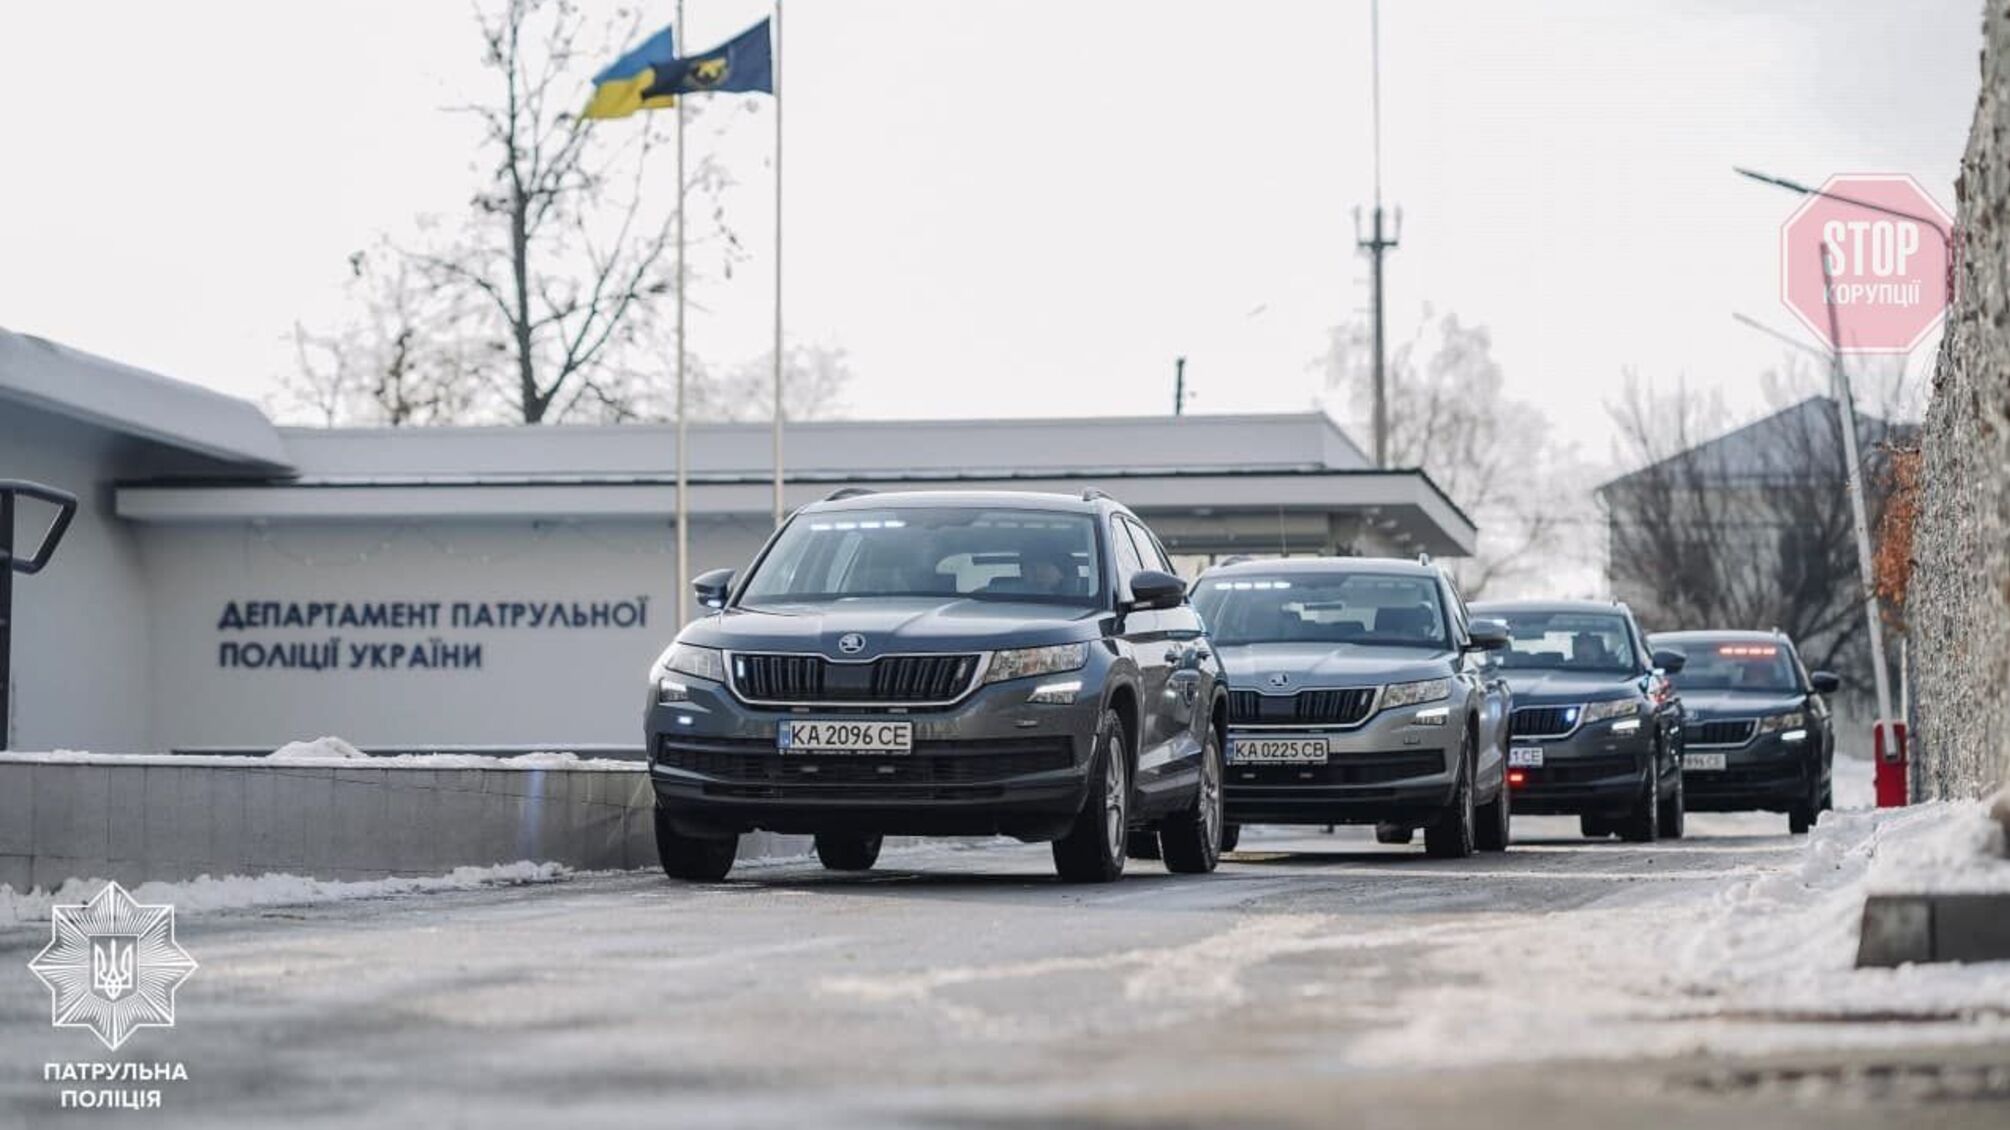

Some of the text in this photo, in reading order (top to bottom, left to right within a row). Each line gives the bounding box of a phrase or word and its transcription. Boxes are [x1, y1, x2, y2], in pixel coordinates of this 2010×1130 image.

[218, 596, 649, 629] ДЕПАРТАМЕНТ ПАТРУЛЬНОЇ
[219, 638, 482, 670] ПОЛІЦІЇ УКРАЇНИ
[792, 725, 820, 745] KA
[825, 725, 873, 745] 2096
[878, 726, 908, 746] CE
[1235, 742, 1324, 758] KA 0225 CB
[1522, 750, 1541, 763] CE
